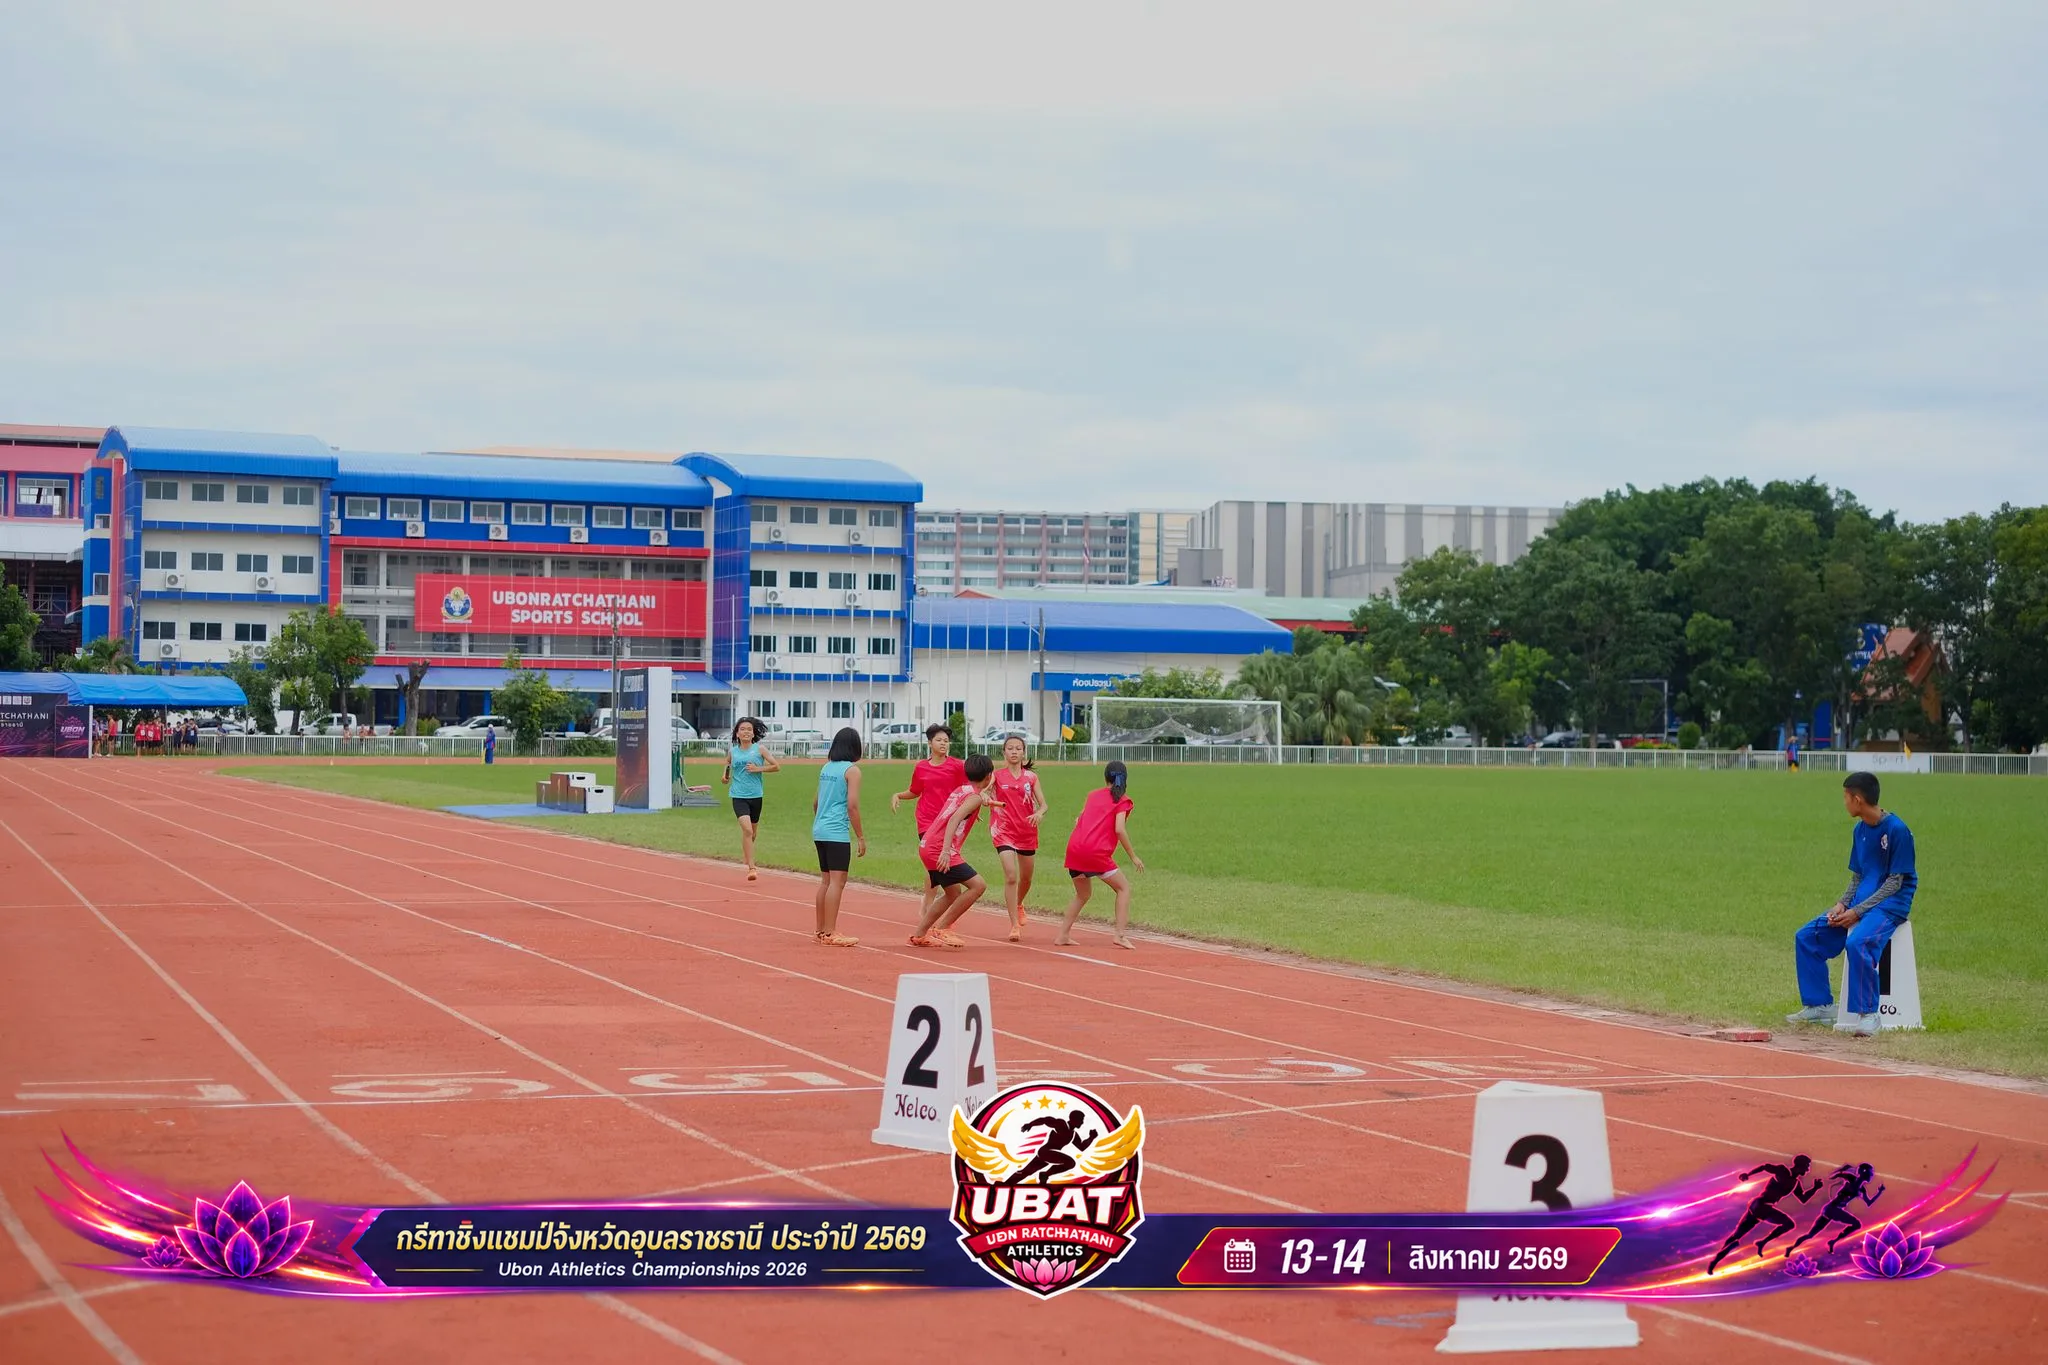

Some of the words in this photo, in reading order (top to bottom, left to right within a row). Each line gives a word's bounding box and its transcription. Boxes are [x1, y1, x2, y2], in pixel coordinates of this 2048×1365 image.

[492, 590, 656, 608] UBONRATCHATHANI
[511, 608, 573, 624] SPORTS
[581, 609, 643, 626] SCHOOL
[1872, 754, 1904, 766] Sprt
[902, 1004, 941, 1089] 2
[965, 1003, 986, 1088] 2
[894, 1094, 938, 1122] Nelco
[1504, 1134, 1573, 1213] 3
